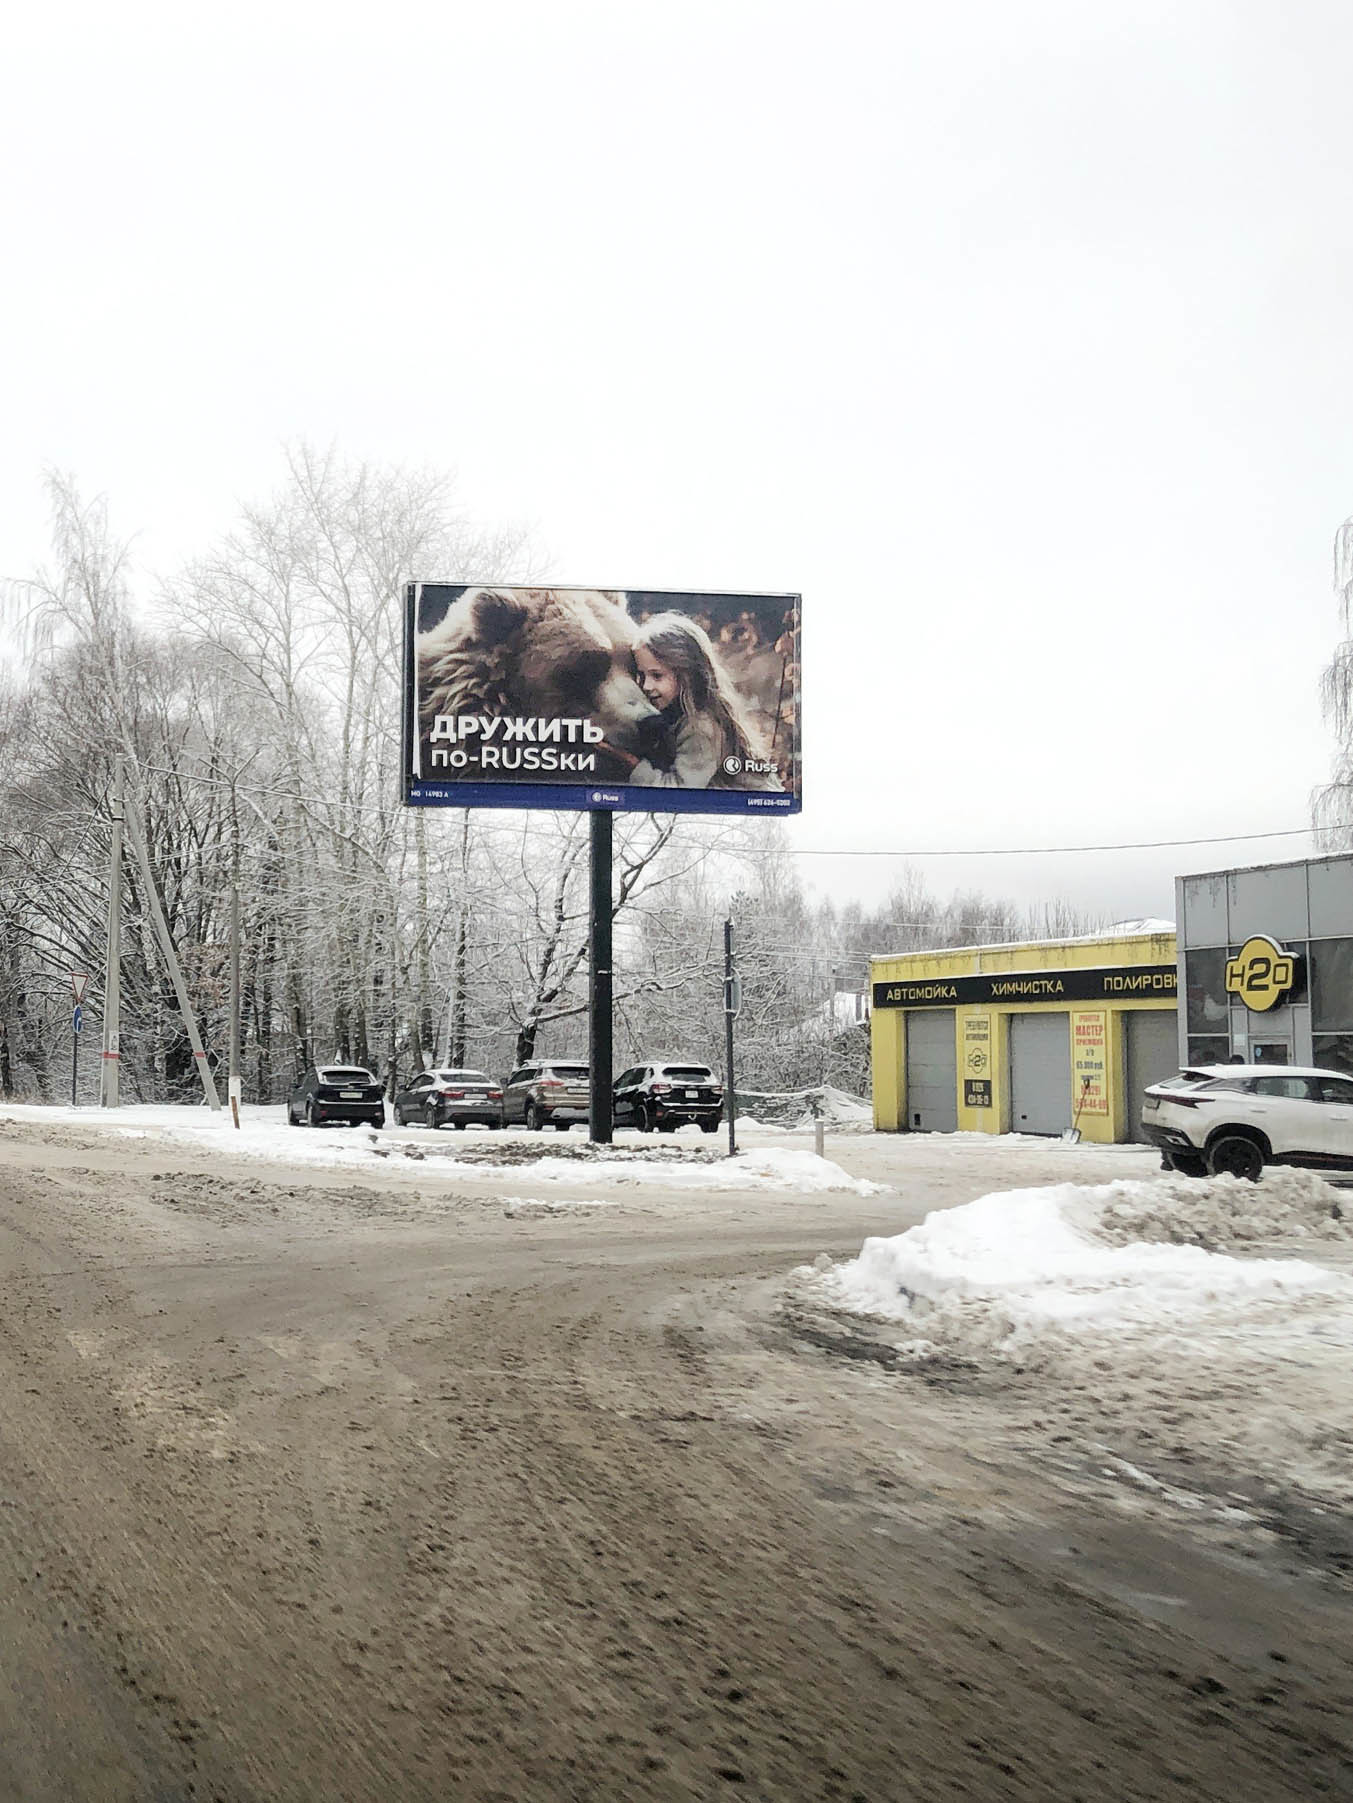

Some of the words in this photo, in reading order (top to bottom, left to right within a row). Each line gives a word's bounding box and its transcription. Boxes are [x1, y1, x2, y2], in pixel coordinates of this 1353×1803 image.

[430, 715, 604, 743] ДРУЖИТЬ
[431, 746, 595, 771] по-RUSSки
[745, 759, 778, 773] Russ
[1229, 957, 1289, 991] H2O
[886, 984, 957, 1001] АВТОМОЙКА
[991, 979, 1064, 996] ХИМЧИСТКА
